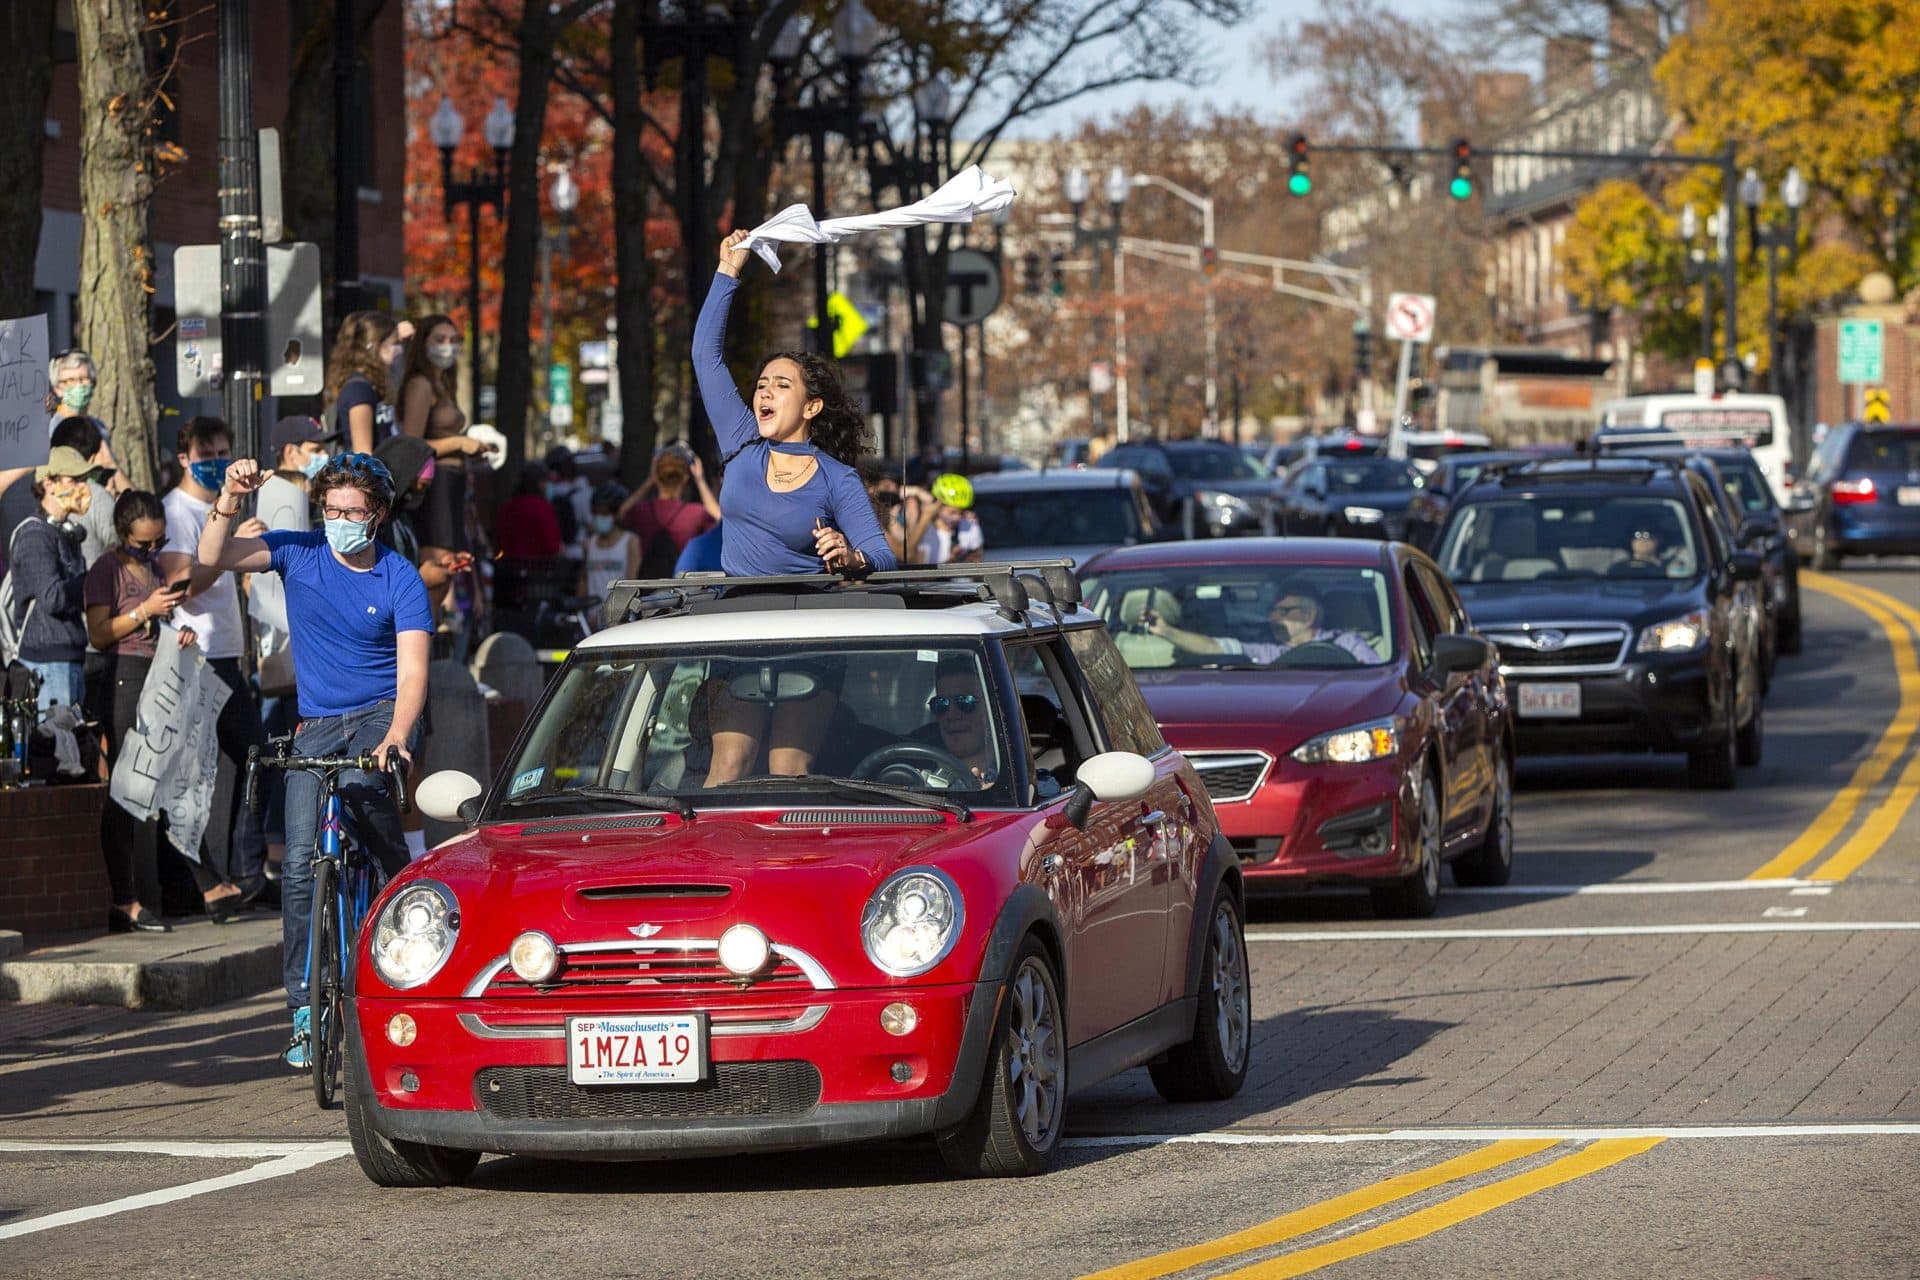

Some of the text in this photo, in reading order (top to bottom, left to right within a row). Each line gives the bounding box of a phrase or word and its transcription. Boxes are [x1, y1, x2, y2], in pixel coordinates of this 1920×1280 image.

[948, 273, 988, 314] T
[578, 1021, 669, 1033] SEP Massachusetts
[580, 1034, 690, 1068] 1MZA 19
[616, 1071, 633, 1079] Spirit
[634, 1071, 641, 1079] of
[642, 1070, 670, 1078] America
